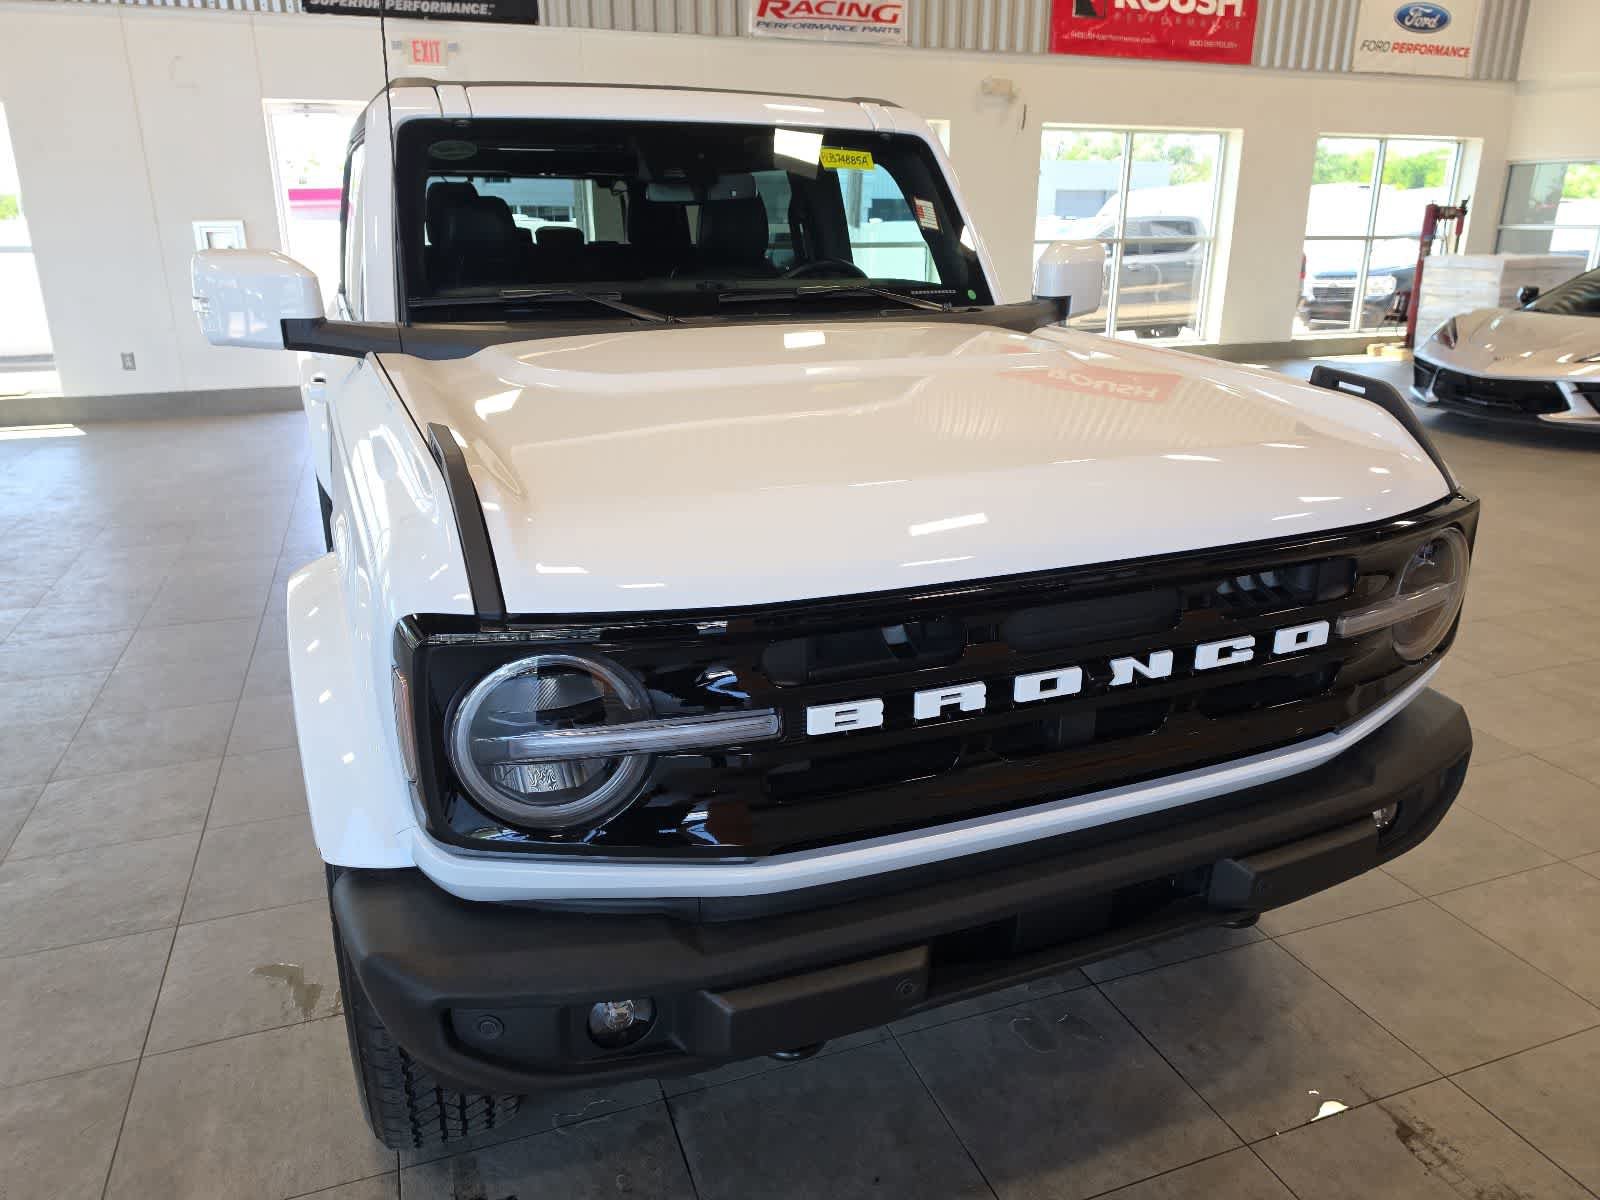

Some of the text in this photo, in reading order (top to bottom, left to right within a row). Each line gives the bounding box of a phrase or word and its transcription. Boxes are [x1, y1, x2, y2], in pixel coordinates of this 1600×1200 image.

[757, 0, 902, 24] RACING
[1404, 6, 1441, 28] Ford
[756, 20, 901, 34] PERFORMANCE PARTS
[411, 39, 441, 64] EXIT
[1360, 40, 1471, 58] FORD PERFORMANCE
[806, 620, 1330, 736] BRONCO
